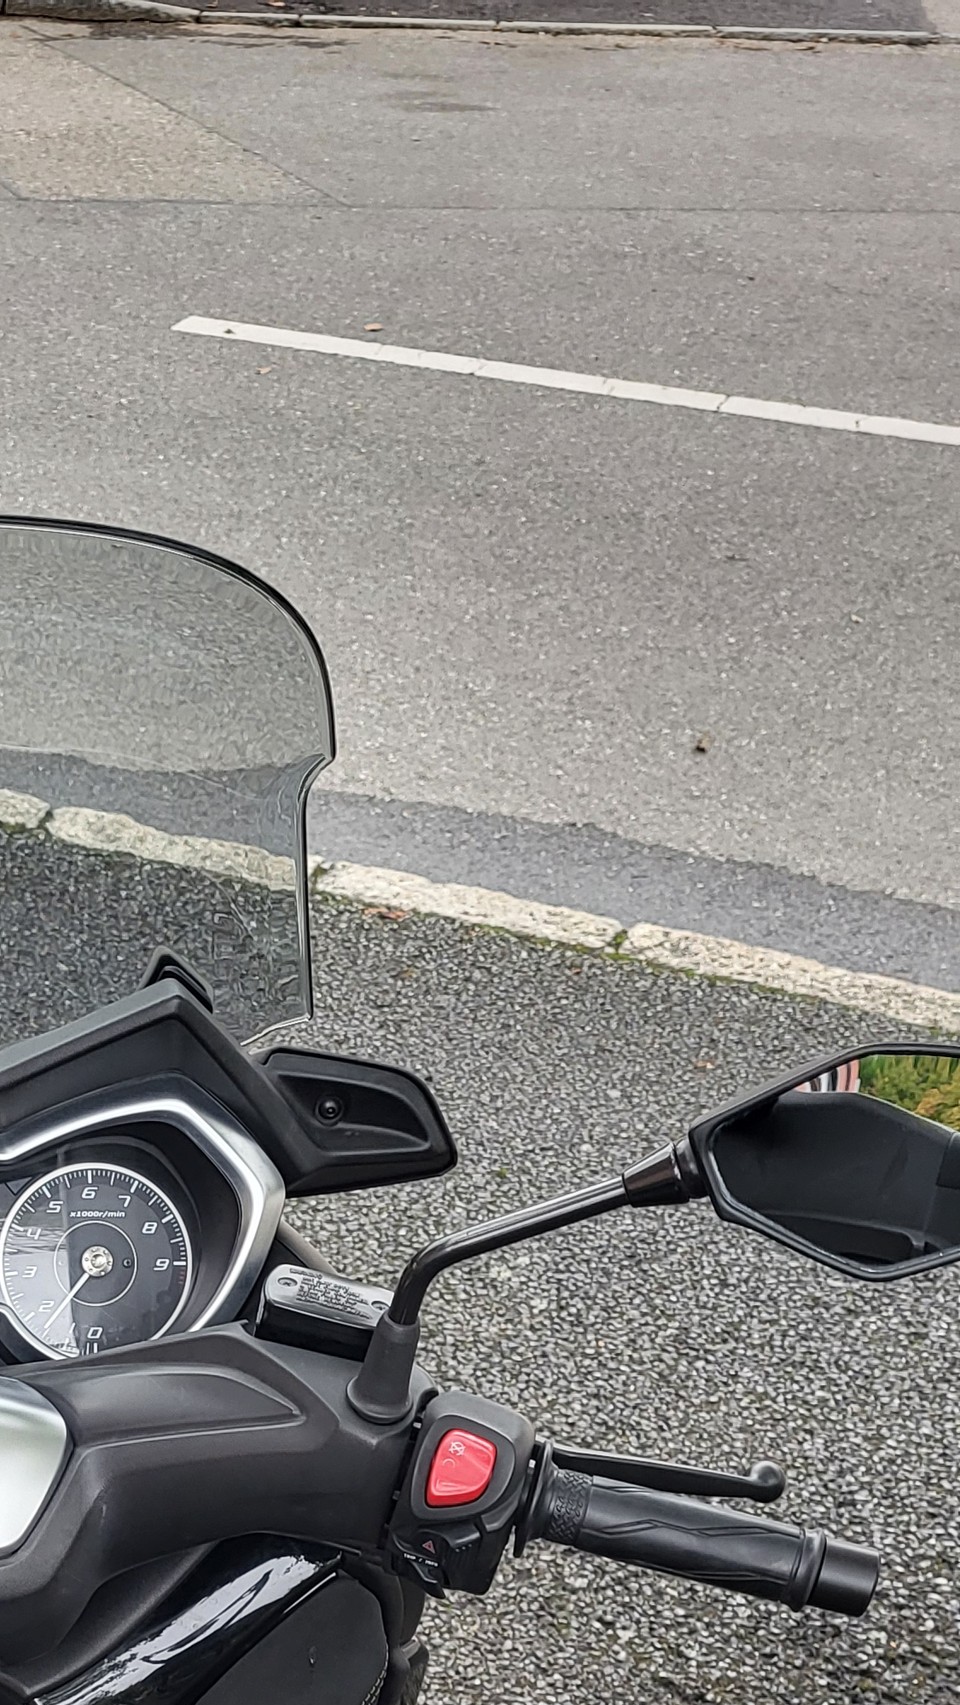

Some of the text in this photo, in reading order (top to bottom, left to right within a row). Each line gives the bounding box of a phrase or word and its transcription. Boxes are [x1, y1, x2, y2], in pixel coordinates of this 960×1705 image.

[81, 1186, 98, 1199] 6
[46, 1200, 64, 1213] 5
[118, 1195, 132, 1207] 7
[69, 1210, 126, 1219] x1000r/min
[26, 1227, 41, 1240] 4
[141, 1221, 158, 1234] 8
[153, 1258, 170, 1271] 9
[22, 1266, 37, 1278] 3
[38, 1300, 54, 1312] 2
[87, 1326, 103, 1339] 0
